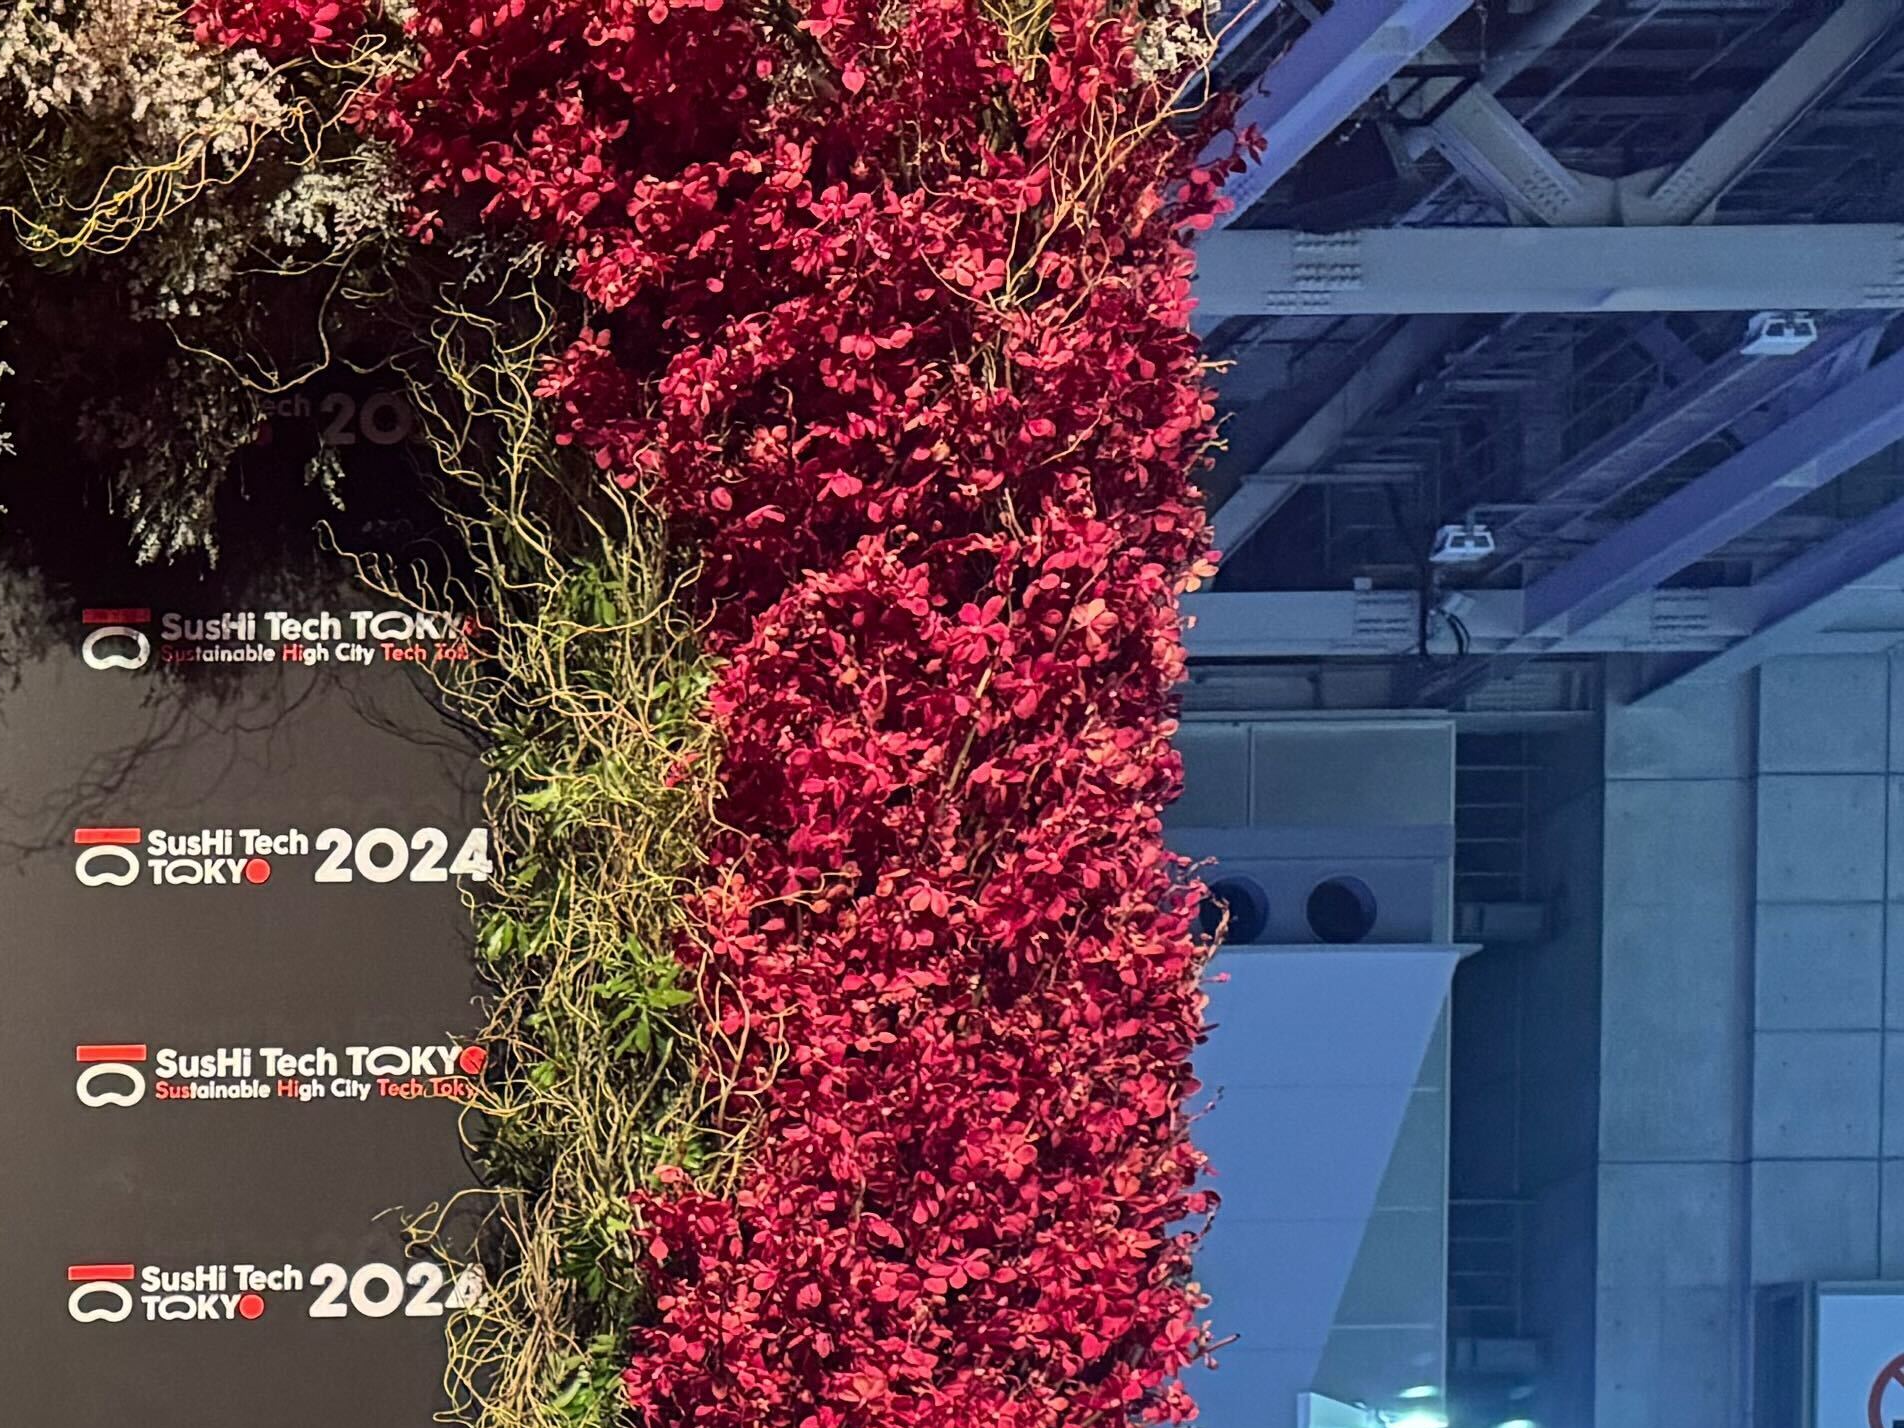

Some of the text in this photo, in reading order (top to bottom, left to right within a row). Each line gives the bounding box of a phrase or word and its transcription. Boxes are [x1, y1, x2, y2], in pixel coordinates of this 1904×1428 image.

[148, 829, 308, 856] SusHi Tech
[314, 828, 490, 882] 2024
[148, 859, 270, 884] TOKYO
